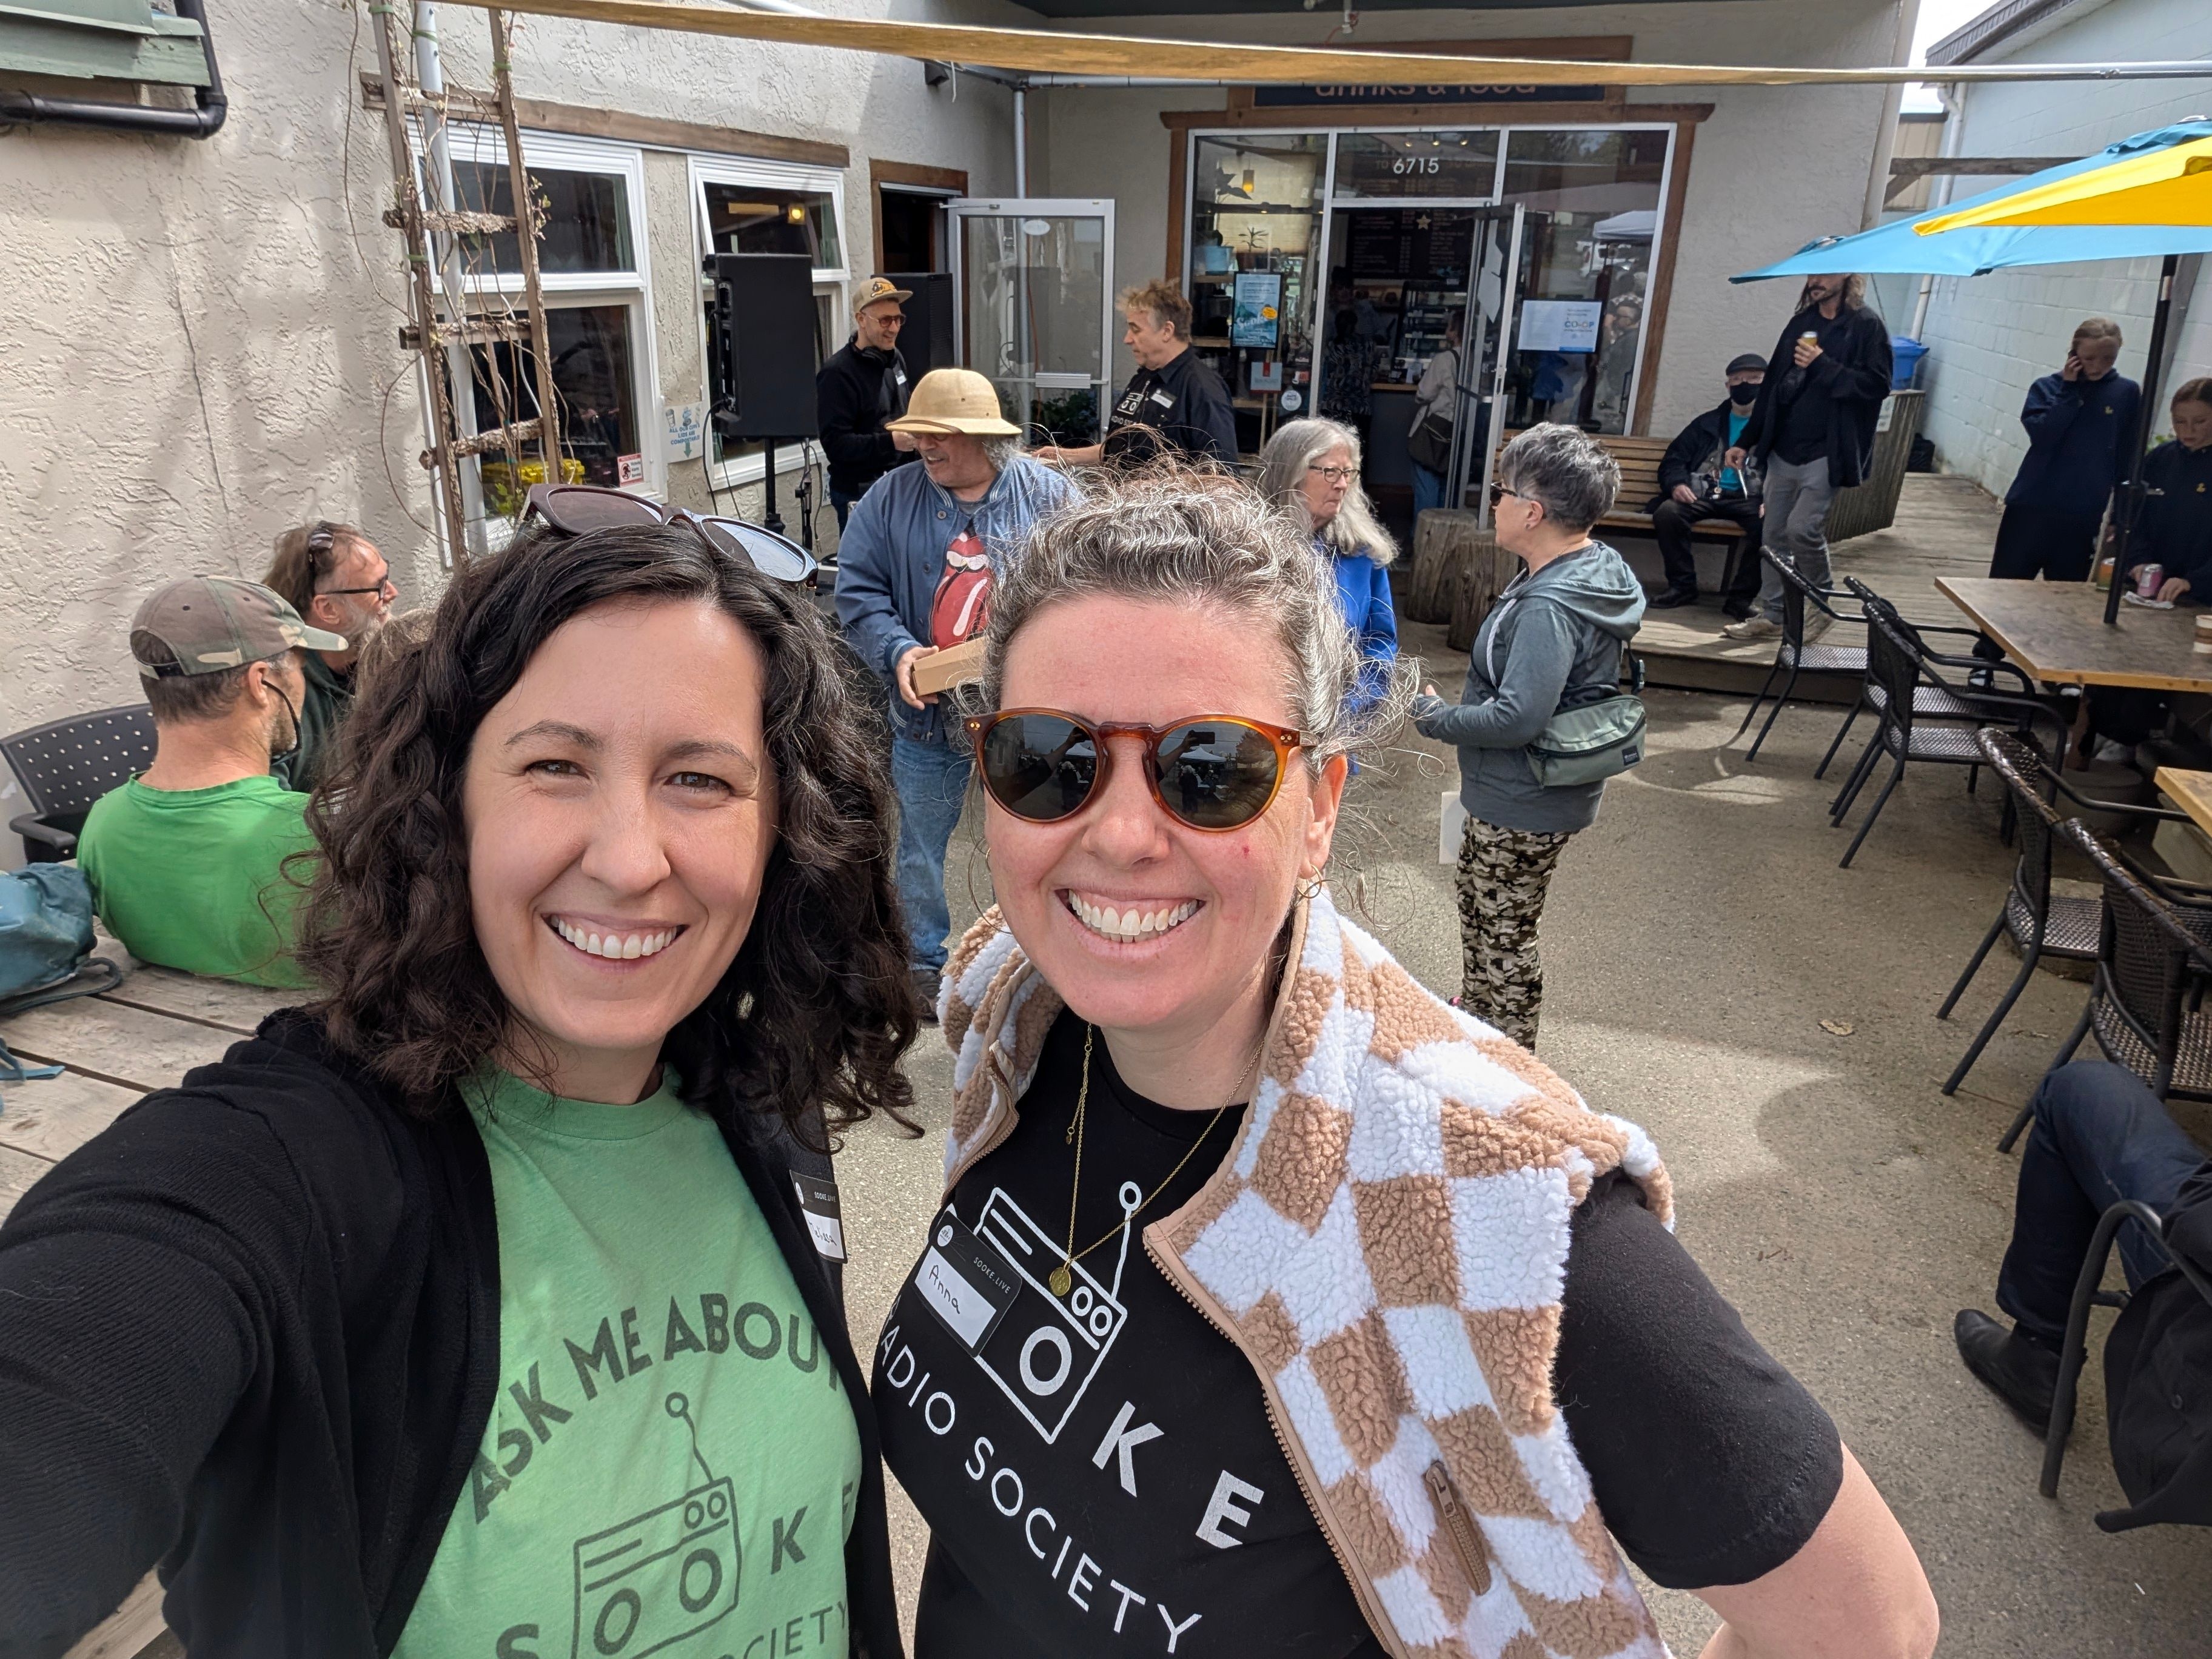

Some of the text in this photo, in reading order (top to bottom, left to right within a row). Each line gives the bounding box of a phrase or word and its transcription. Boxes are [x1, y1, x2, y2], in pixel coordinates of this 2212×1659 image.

[1393, 157, 1439, 174] 6715
[928, 1265, 960, 1315] Anna
[973, 1257, 1011, 1294] SOOKE.LIVE
[472, 1361, 574, 1524] ASK
[563, 1307, 653, 1401] ME
[965, 1437, 1202, 1655] SOCIETY
